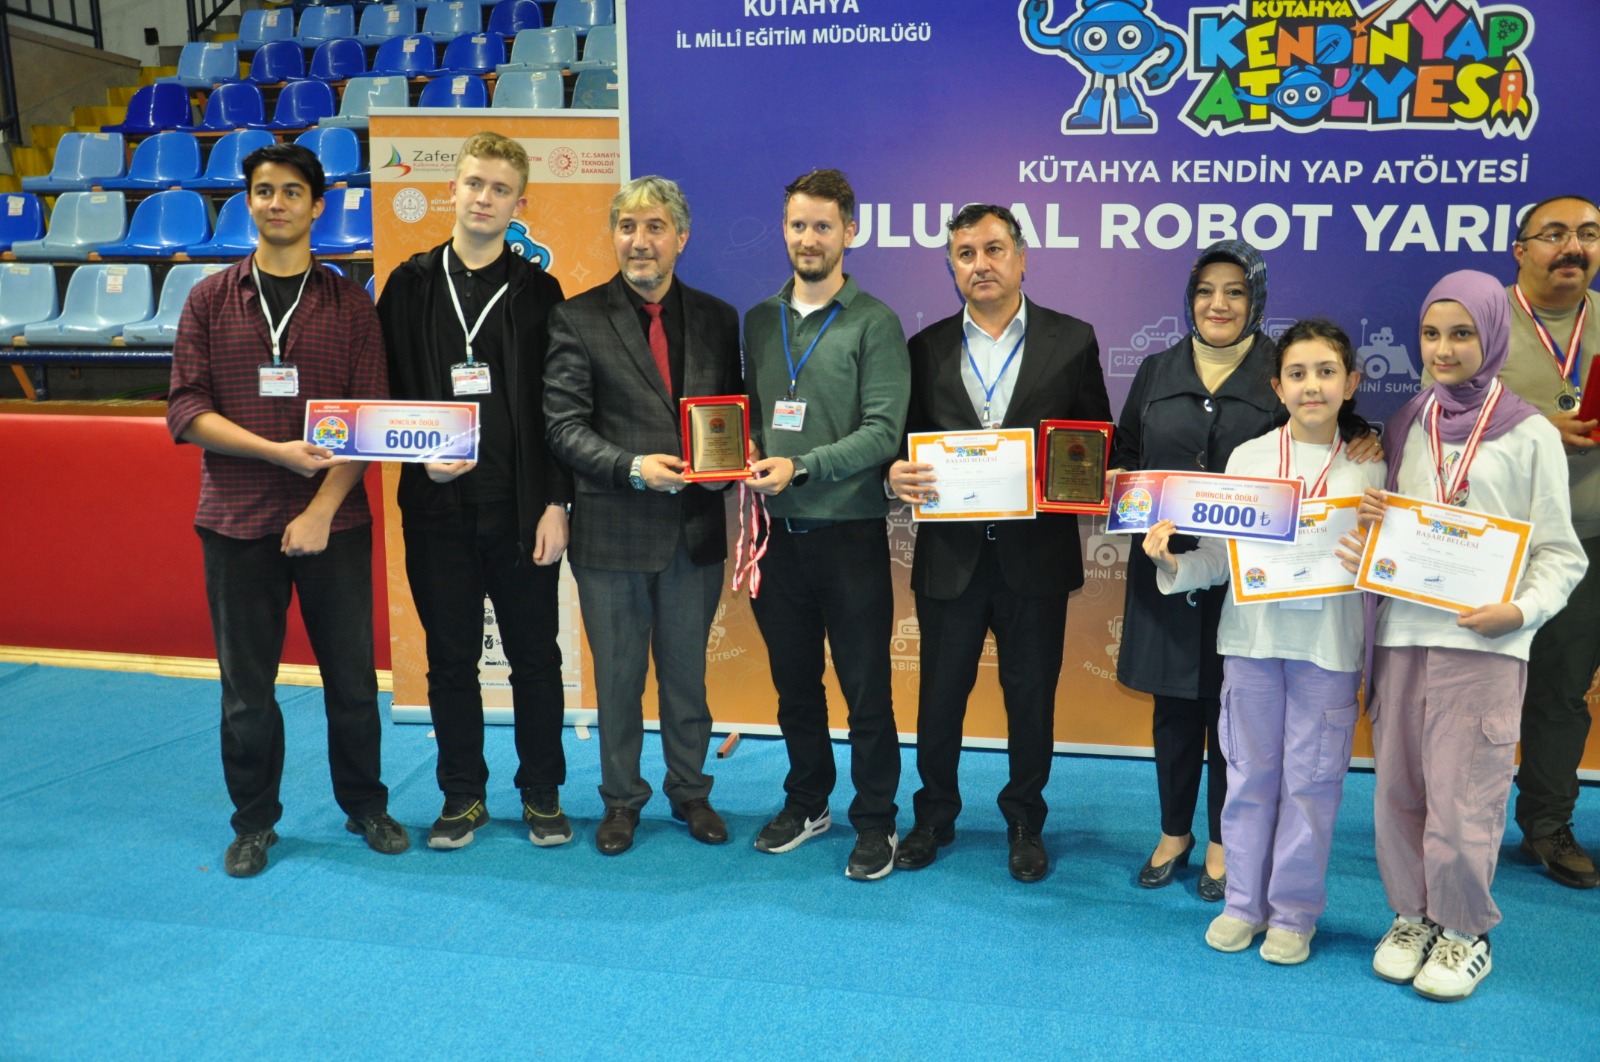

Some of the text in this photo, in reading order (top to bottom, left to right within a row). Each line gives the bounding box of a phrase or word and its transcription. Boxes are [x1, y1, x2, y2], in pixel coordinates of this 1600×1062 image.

[676, 30, 691, 48] İL
[745, 27, 806, 46] EĞİTİM
[812, 22, 931, 43] MÜDÜRLÜĞÜ
[413, 150, 457, 162] Zafer
[1019, 153, 1529, 184] KÜTAHYA KENDİN YAP ATÖLYESİ
[849, 202, 1080, 249] ULUAL
[1100, 203, 1333, 251] ROBOT
[1114, 354, 1148, 367] ÇİZG
[385, 430, 441, 450] 6000
[1195, 491, 1259, 502] BİRİNCİLİK ÖDÜLÜ
[1191, 503, 1257, 528] 8000
[707, 646, 747, 662] UTBOL
[1083, 661, 1118, 681] ROBO
